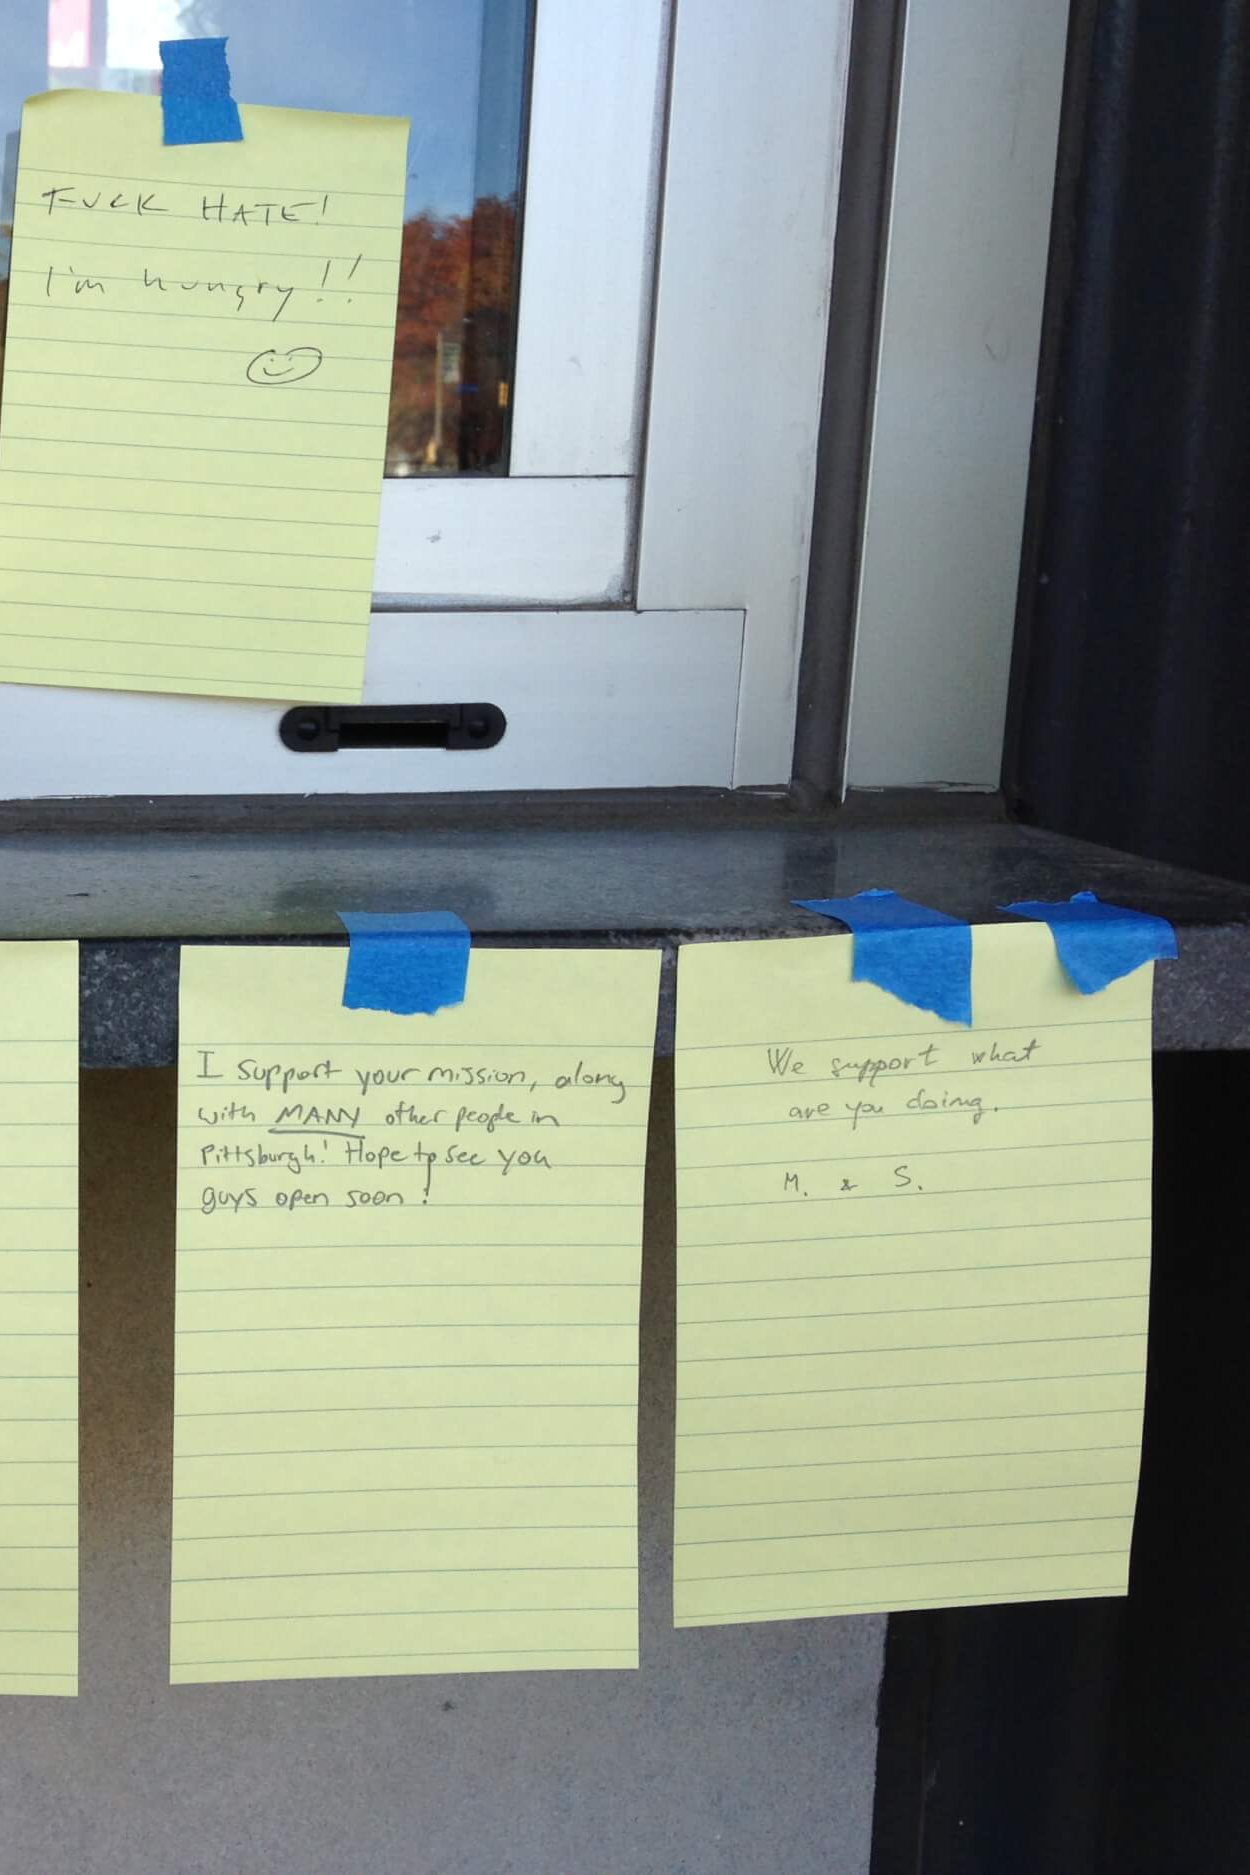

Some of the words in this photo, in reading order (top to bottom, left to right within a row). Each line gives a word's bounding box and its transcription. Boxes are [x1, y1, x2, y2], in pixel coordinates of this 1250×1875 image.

[41, 186, 169, 216] FUCK
[201, 192, 329, 227] HATE!
[45, 265, 105, 297] I'm
[143, 253, 363, 322] hungry!!
[196, 1049, 224, 1080] I
[356, 1067, 422, 1096] your
[427, 1065, 538, 1094] mission,
[554, 1060, 627, 1104] along
[766, 1046, 807, 1077] We
[830, 1043, 941, 1087] support
[970, 1038, 1042, 1065] what
[197, 1100, 257, 1123] with
[274, 1103, 361, 1127] MANY
[385, 1102, 446, 1126] other
[454, 1103, 523, 1134] people
[530, 1109, 560, 1128] in
[788, 1102, 831, 1121] are
[844, 1100, 885, 1131] you
[905, 1087, 1000, 1125] doing.
[344, 1139, 409, 1170] Hope
[497, 1146, 553, 1176] you
[200, 1186, 258, 1215] guys
[274, 1187, 330, 1215] open
[782, 1171, 809, 1197] M.
[893, 1164, 924, 1191] S.
